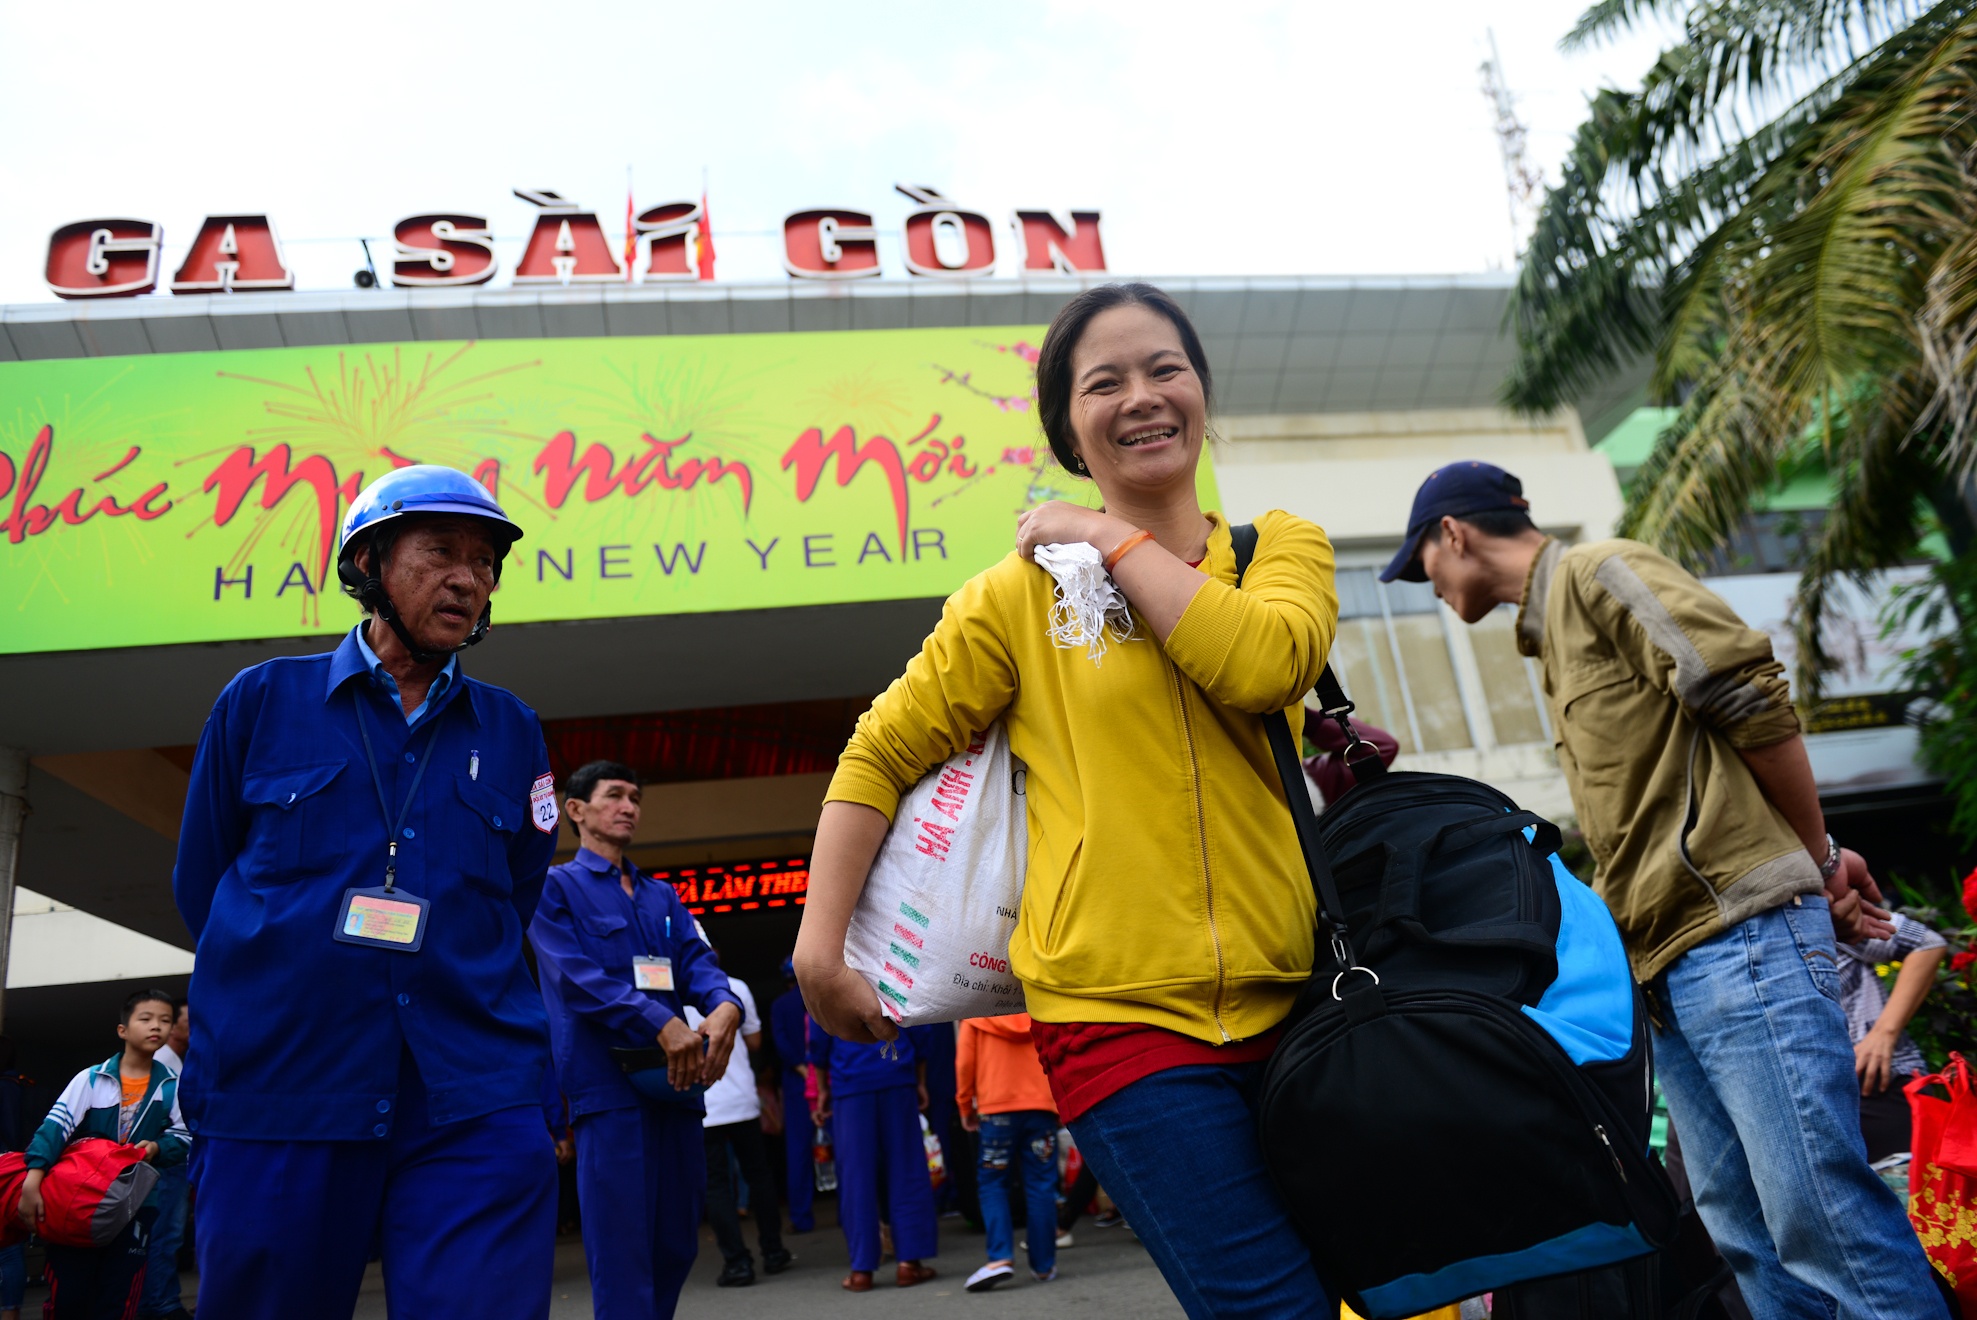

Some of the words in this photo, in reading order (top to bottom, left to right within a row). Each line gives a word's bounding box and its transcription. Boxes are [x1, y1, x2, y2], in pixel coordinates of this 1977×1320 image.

[44, 212, 294, 300] GA
[391, 188, 700, 288] SÀI
[783, 184, 1107, 278] GÒN
[780, 413, 977, 563] Mới
[537, 541, 706, 583] NEW
[745, 528, 948, 571] YEAR
[540, 803, 554, 822] 22
[931, 765, 974, 821] ANH
[953, 973, 969, 989] Địa
[991, 982, 1011, 995] Khối
[969, 951, 1007, 973] CÔNG
